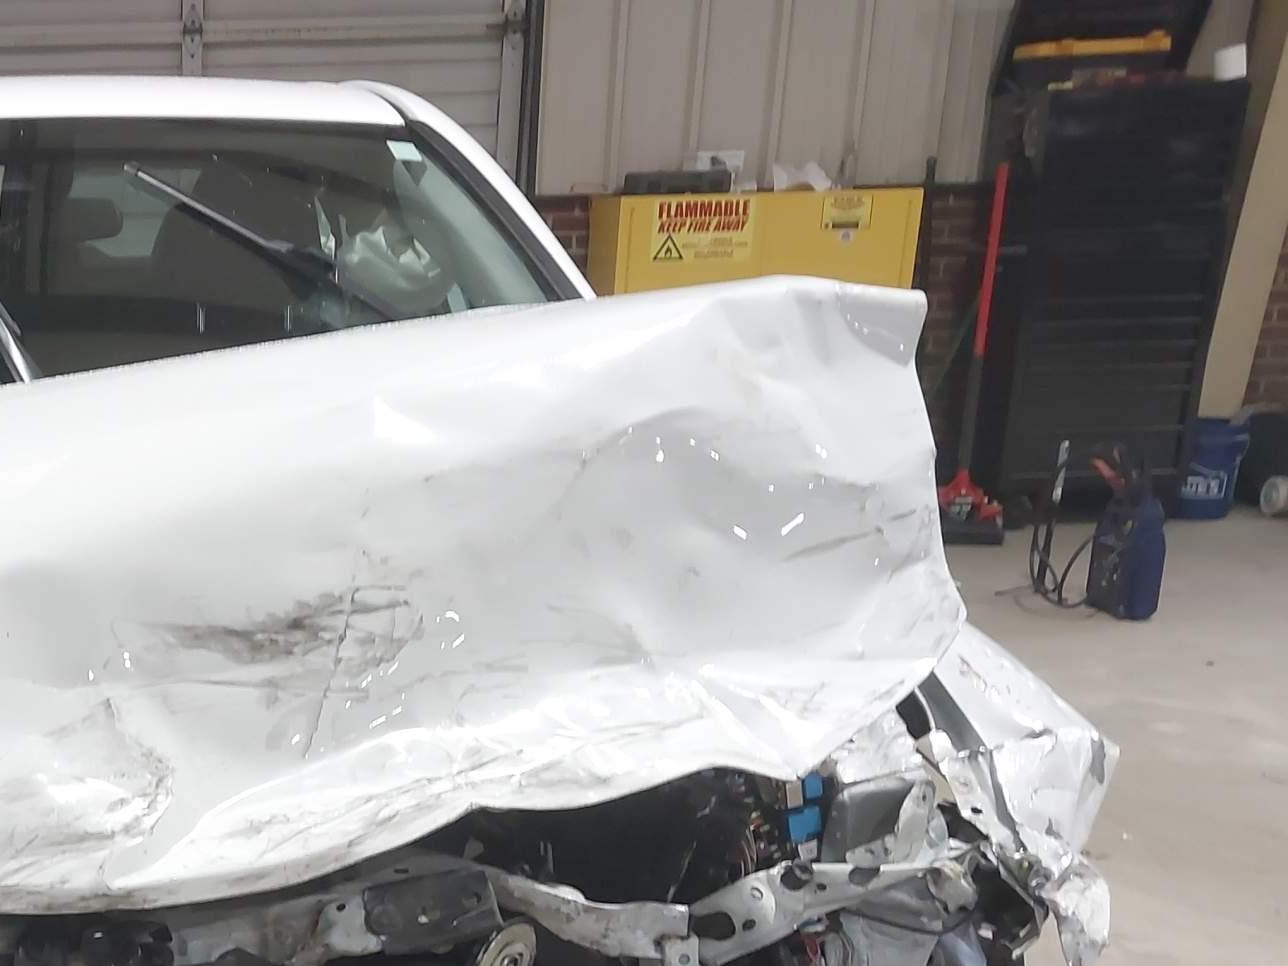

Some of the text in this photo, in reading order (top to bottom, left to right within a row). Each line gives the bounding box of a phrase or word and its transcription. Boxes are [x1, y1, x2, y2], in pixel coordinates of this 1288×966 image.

[658, 199, 750, 219] FLAMMABLE
[657, 216, 748, 233] KEEP FIRE AWAY
